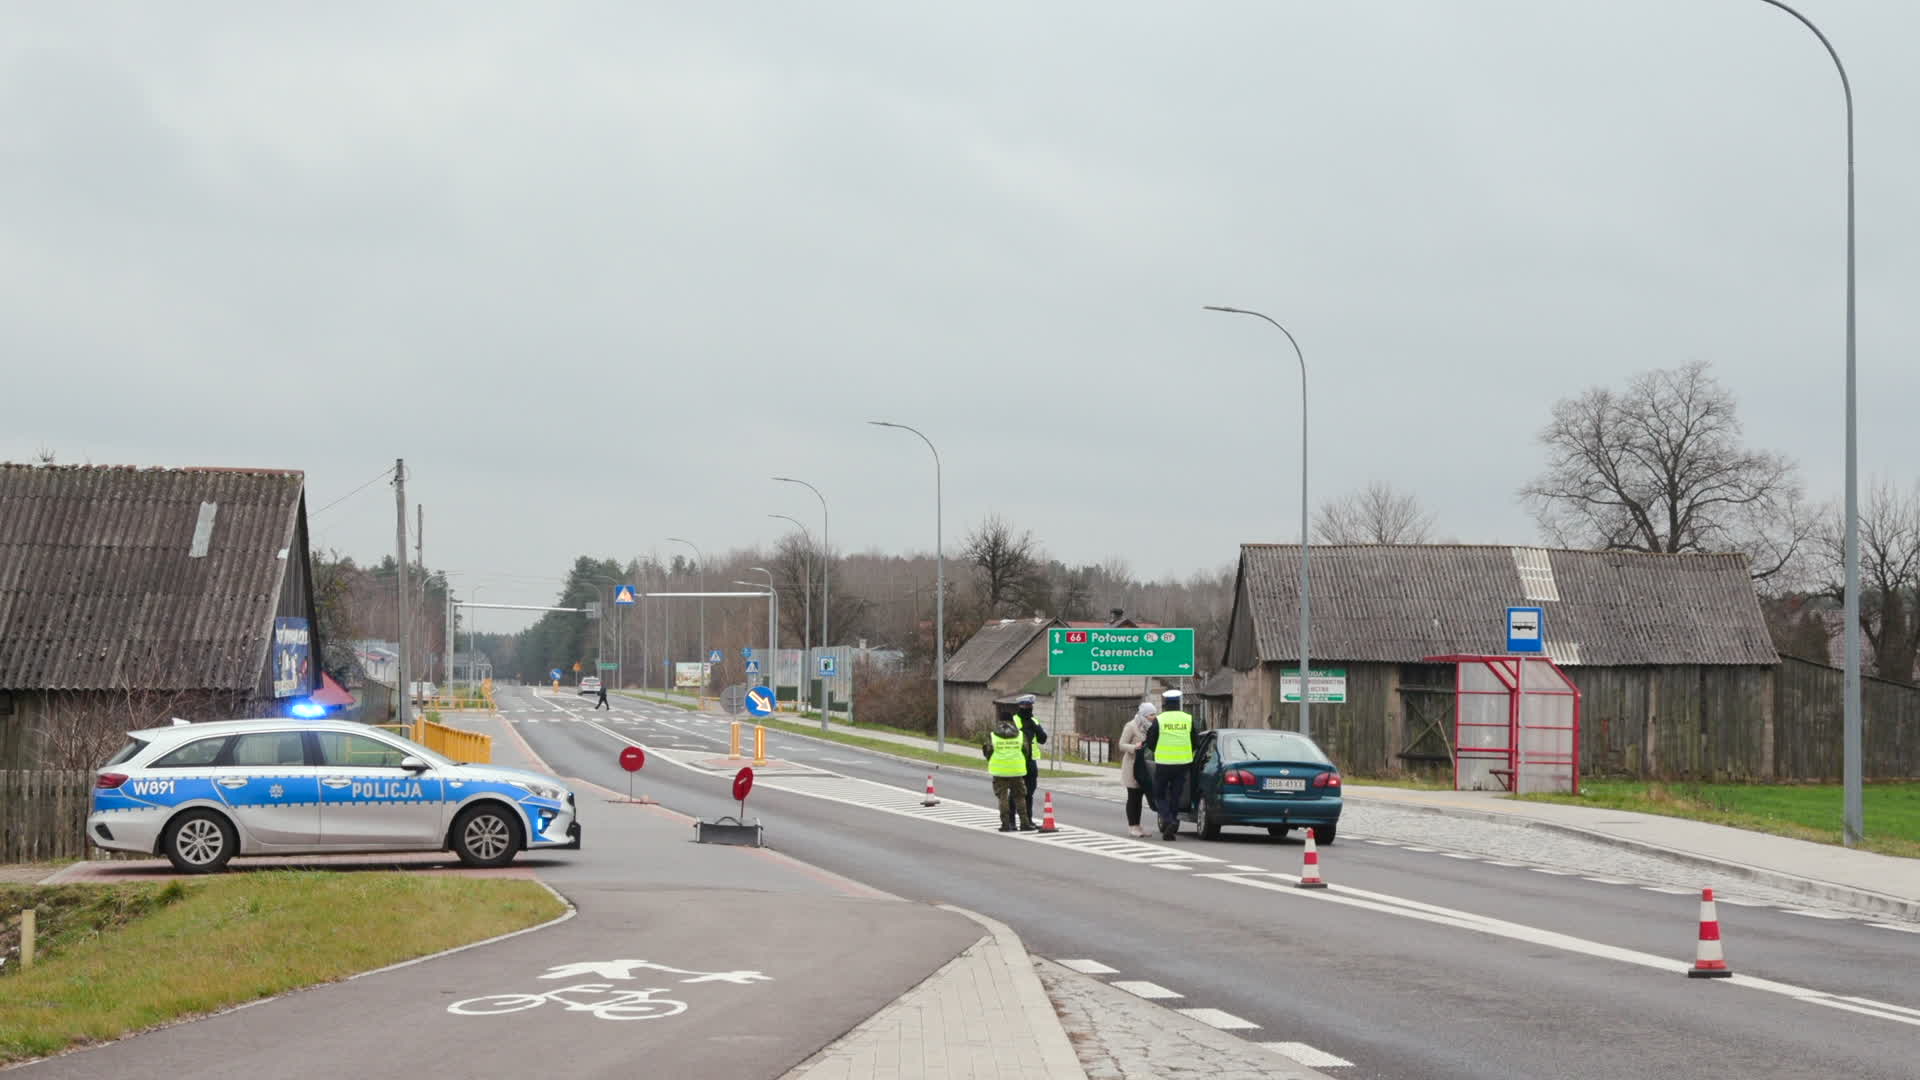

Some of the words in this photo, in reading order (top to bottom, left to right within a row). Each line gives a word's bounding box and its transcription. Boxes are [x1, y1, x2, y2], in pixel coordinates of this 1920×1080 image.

[1070, 633, 1081, 641] 66
[1091, 632, 1139, 643] Połowce
[1146, 633, 1155, 641] PL
[1091, 647, 1154, 657] Czeremcha
[1091, 661, 1125, 671] Dasze
[133, 781, 175, 796] W891
[352, 782, 423, 798] POLICJA
